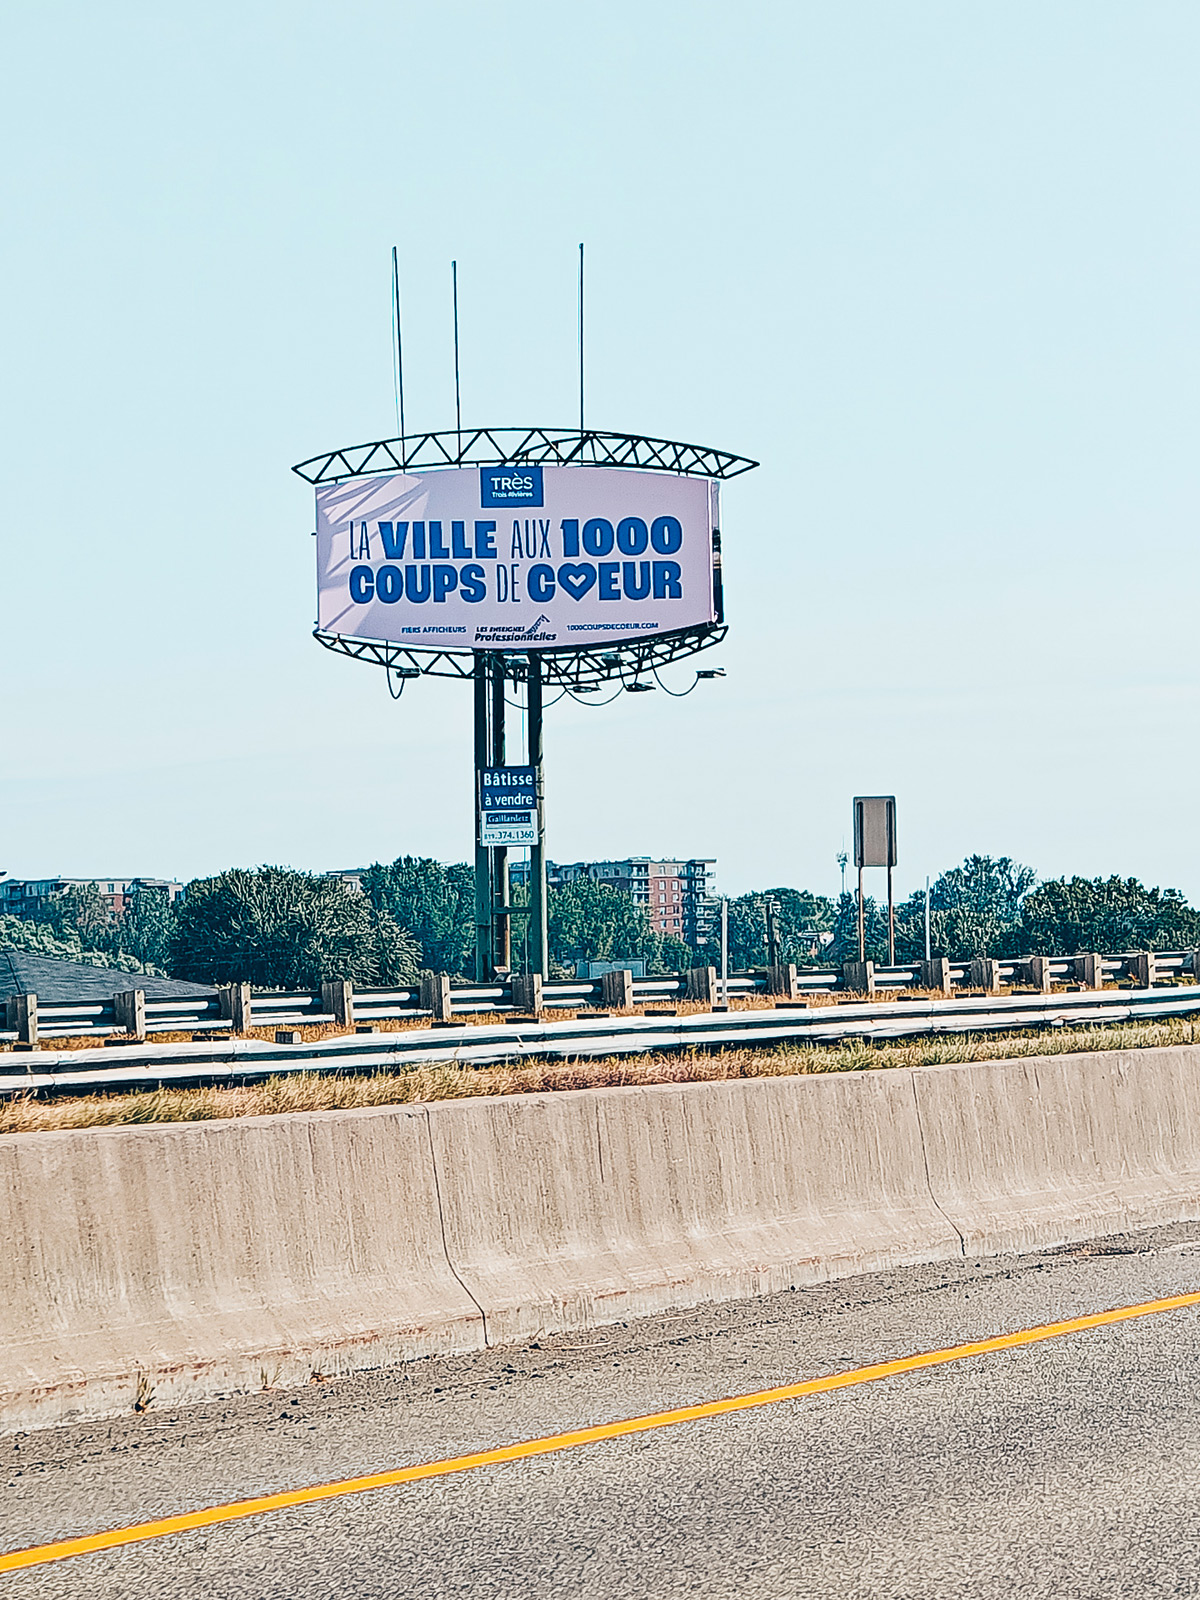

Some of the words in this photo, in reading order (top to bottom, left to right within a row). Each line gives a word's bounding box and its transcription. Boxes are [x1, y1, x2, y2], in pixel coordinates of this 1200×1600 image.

[350, 521, 371, 560] LA
[378, 520, 498, 560] VILLE
[511, 519, 552, 559] AUX
[560, 516, 683, 557] 1000
[349, 563, 487, 604] COUPS
[496, 563, 521, 603] DE
[484, 772, 533, 786] Bâtisse
[485, 792, 492, 806] à
[495, 792, 533, 805] vendre
